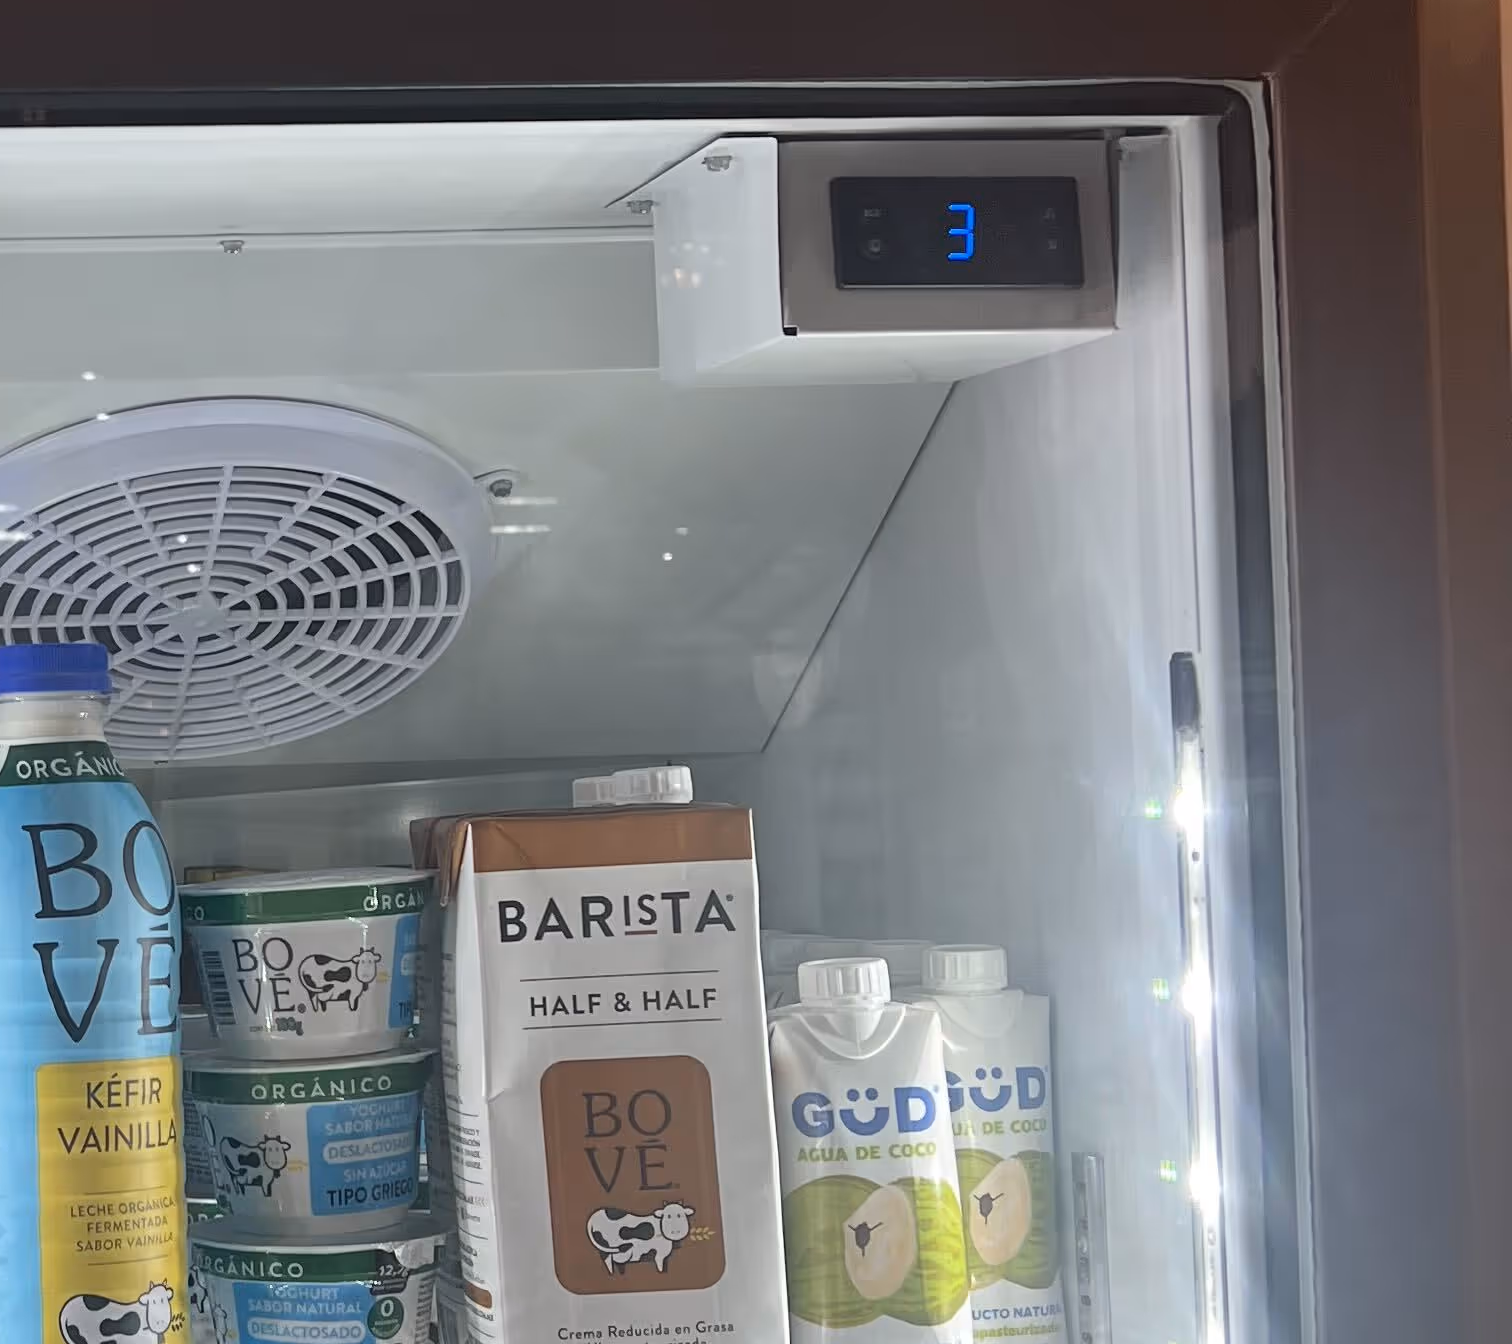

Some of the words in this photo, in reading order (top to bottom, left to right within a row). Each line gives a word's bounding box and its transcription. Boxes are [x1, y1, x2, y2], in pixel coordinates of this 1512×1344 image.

[947, 203, 975, 262] 3
[21, 820, 176, 919] BO
[497, 888, 737, 944] BARISTA
[232, 936, 294, 974] BO
[530, 993, 602, 1017] HALF
[614, 991, 632, 1012] &
[643, 988, 718, 1011] HALF
[86, 1072, 162, 1110] KÉFIR
[251, 1076, 392, 1101] ORGÁNICO
[581, 1089, 672, 1138] BO
[57, 1118, 178, 1155] VAINILLA
[797, 1146, 849, 1163] AGUA
[855, 1145, 882, 1161] DE
[888, 1142, 937, 1159] COCO
[326, 1186, 368, 1208] TIPO
[371, 1177, 414, 1201] GRIEGO
[70, 1202, 114, 1218] LECHE
[87, 1214, 168, 1234] FERMENTADA
[76, 1238, 122, 1252] SABOR
[247, 1300, 293, 1314] SABOR
[296, 1301, 363, 1314] NATURAL
[250, 1322, 362, 1339] DESLACTOSADO
[557, 1327, 603, 1341] Crema
[607, 1322, 670, 1338] Reducida
[674, 1325, 691, 1335] en
[695, 1320, 735, 1334] Grasa
